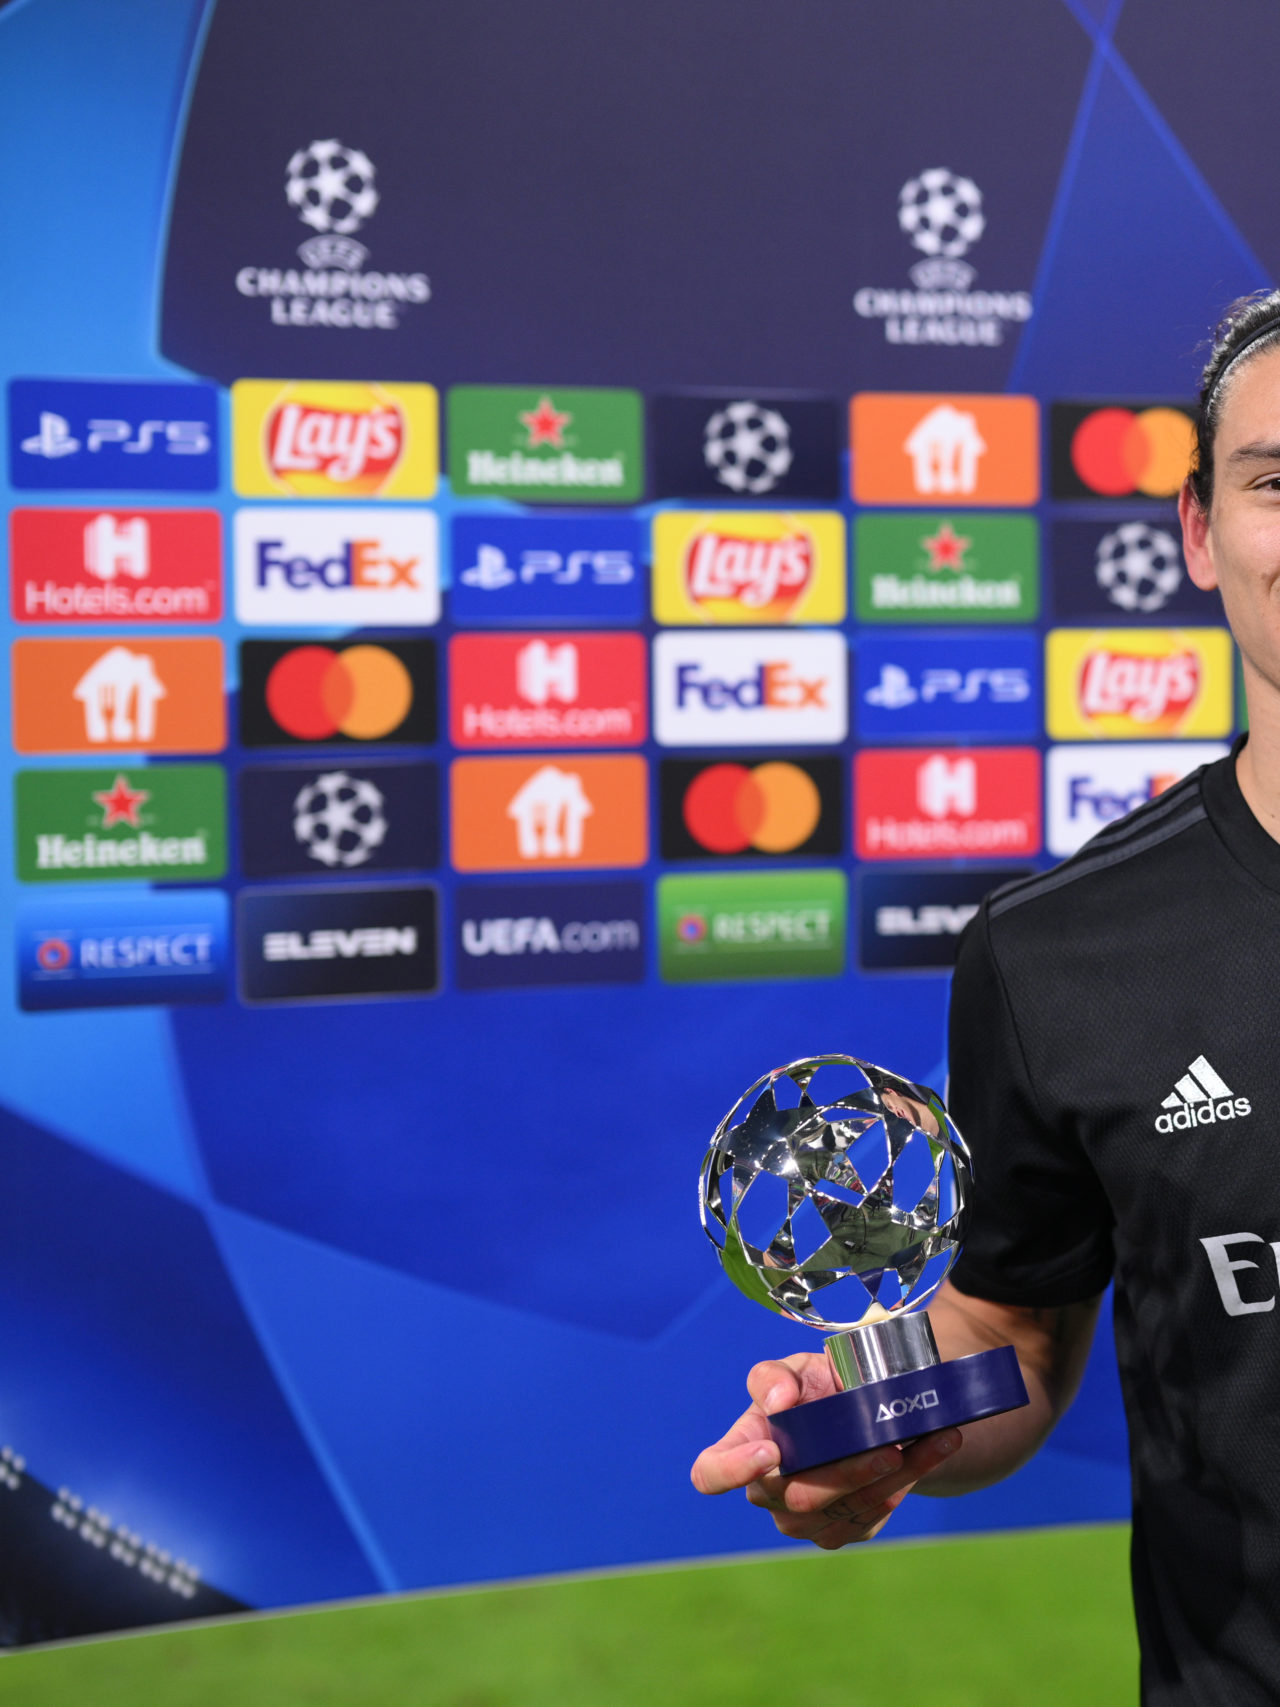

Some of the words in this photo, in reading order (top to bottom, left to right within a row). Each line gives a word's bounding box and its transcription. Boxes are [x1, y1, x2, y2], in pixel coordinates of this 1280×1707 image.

[237, 268, 429, 302] CHAMPIONS
[271, 298, 396, 328] LEAGUE
[855, 289, 1031, 321] CHAMPIONS
[886, 316, 1001, 344] LEAGUE
[88, 419, 210, 455] PS5
[274, 404, 398, 482] Lay's
[468, 450, 624, 487] Heineken
[256, 540, 418, 588] FedEx
[522, 550, 633, 584] PS5
[692, 534, 810, 606] Lay's
[25, 580, 208, 615] Hotels.com
[873, 573, 1021, 608] Heineken
[675, 662, 827, 710] FedEx
[920, 669, 1031, 702] PS5
[1084, 650, 1200, 720] Lay's
[463, 704, 633, 737] Hotels.com
[36, 833, 205, 868] Heineken
[866, 819, 1028, 850] Hotels.com
[462, 917, 640, 956] UEFA.com
[714, 908, 830, 943] RESPECT
[80, 932, 210, 970] RESPECT
[263, 927, 416, 961] ELEVEN
[1155, 1097, 1252, 1133] adidas
